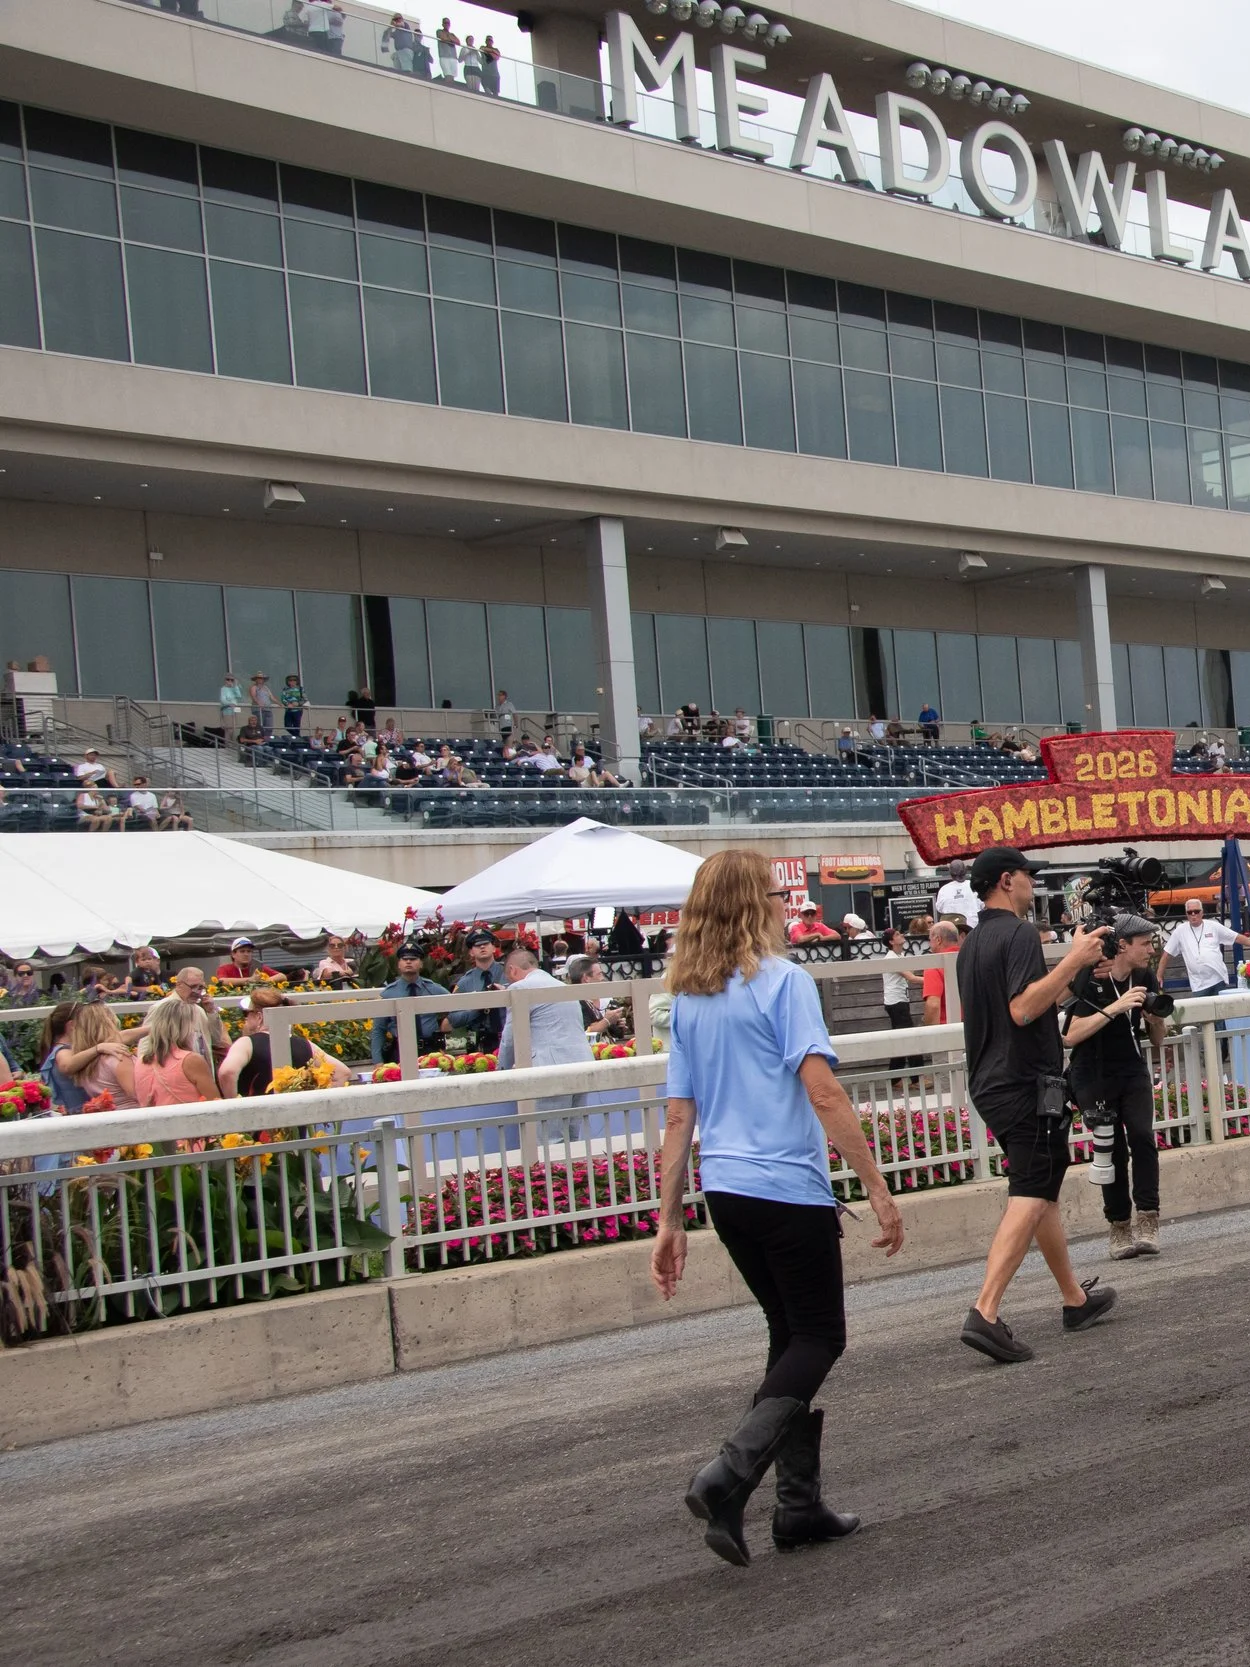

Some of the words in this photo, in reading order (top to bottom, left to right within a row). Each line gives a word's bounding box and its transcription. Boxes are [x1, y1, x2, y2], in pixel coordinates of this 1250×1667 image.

[1074, 749, 1158, 782] 2026
[821, 857, 836, 867] FOOT
[836, 857, 853, 866] LONG
[853, 856, 882, 866] HOTDOGS
